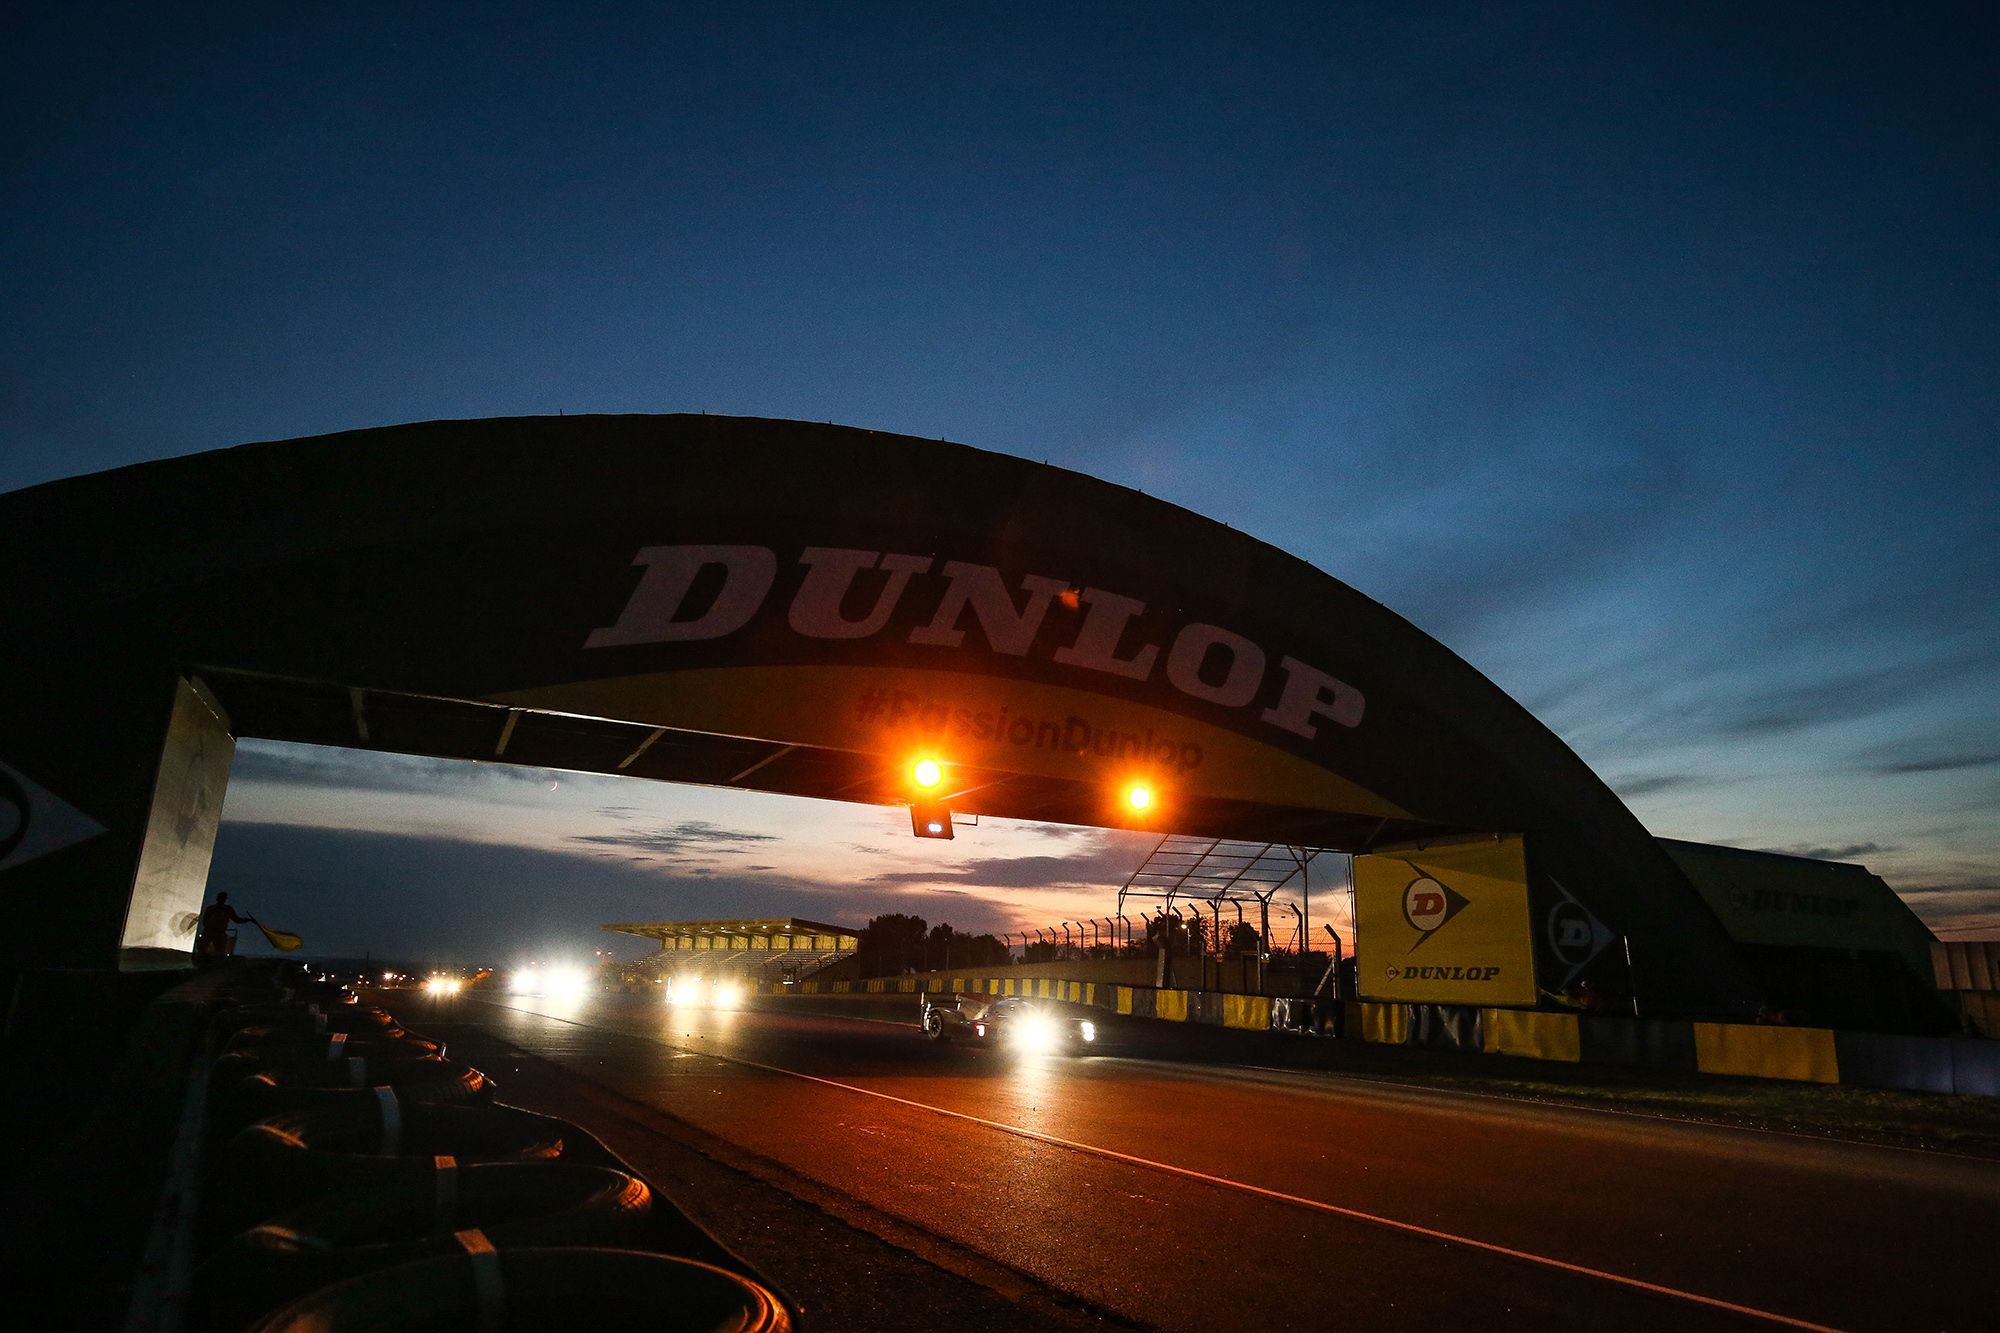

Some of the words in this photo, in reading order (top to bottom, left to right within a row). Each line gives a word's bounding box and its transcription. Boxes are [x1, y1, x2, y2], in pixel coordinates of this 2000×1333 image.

[583, 544, 1366, 739] DUNLOP
[1411, 892, 1444, 916] D
[1752, 889, 1859, 918] DUNLOP
[1558, 918, 1592, 947] D
[1403, 966, 1500, 981] DUNLOP
